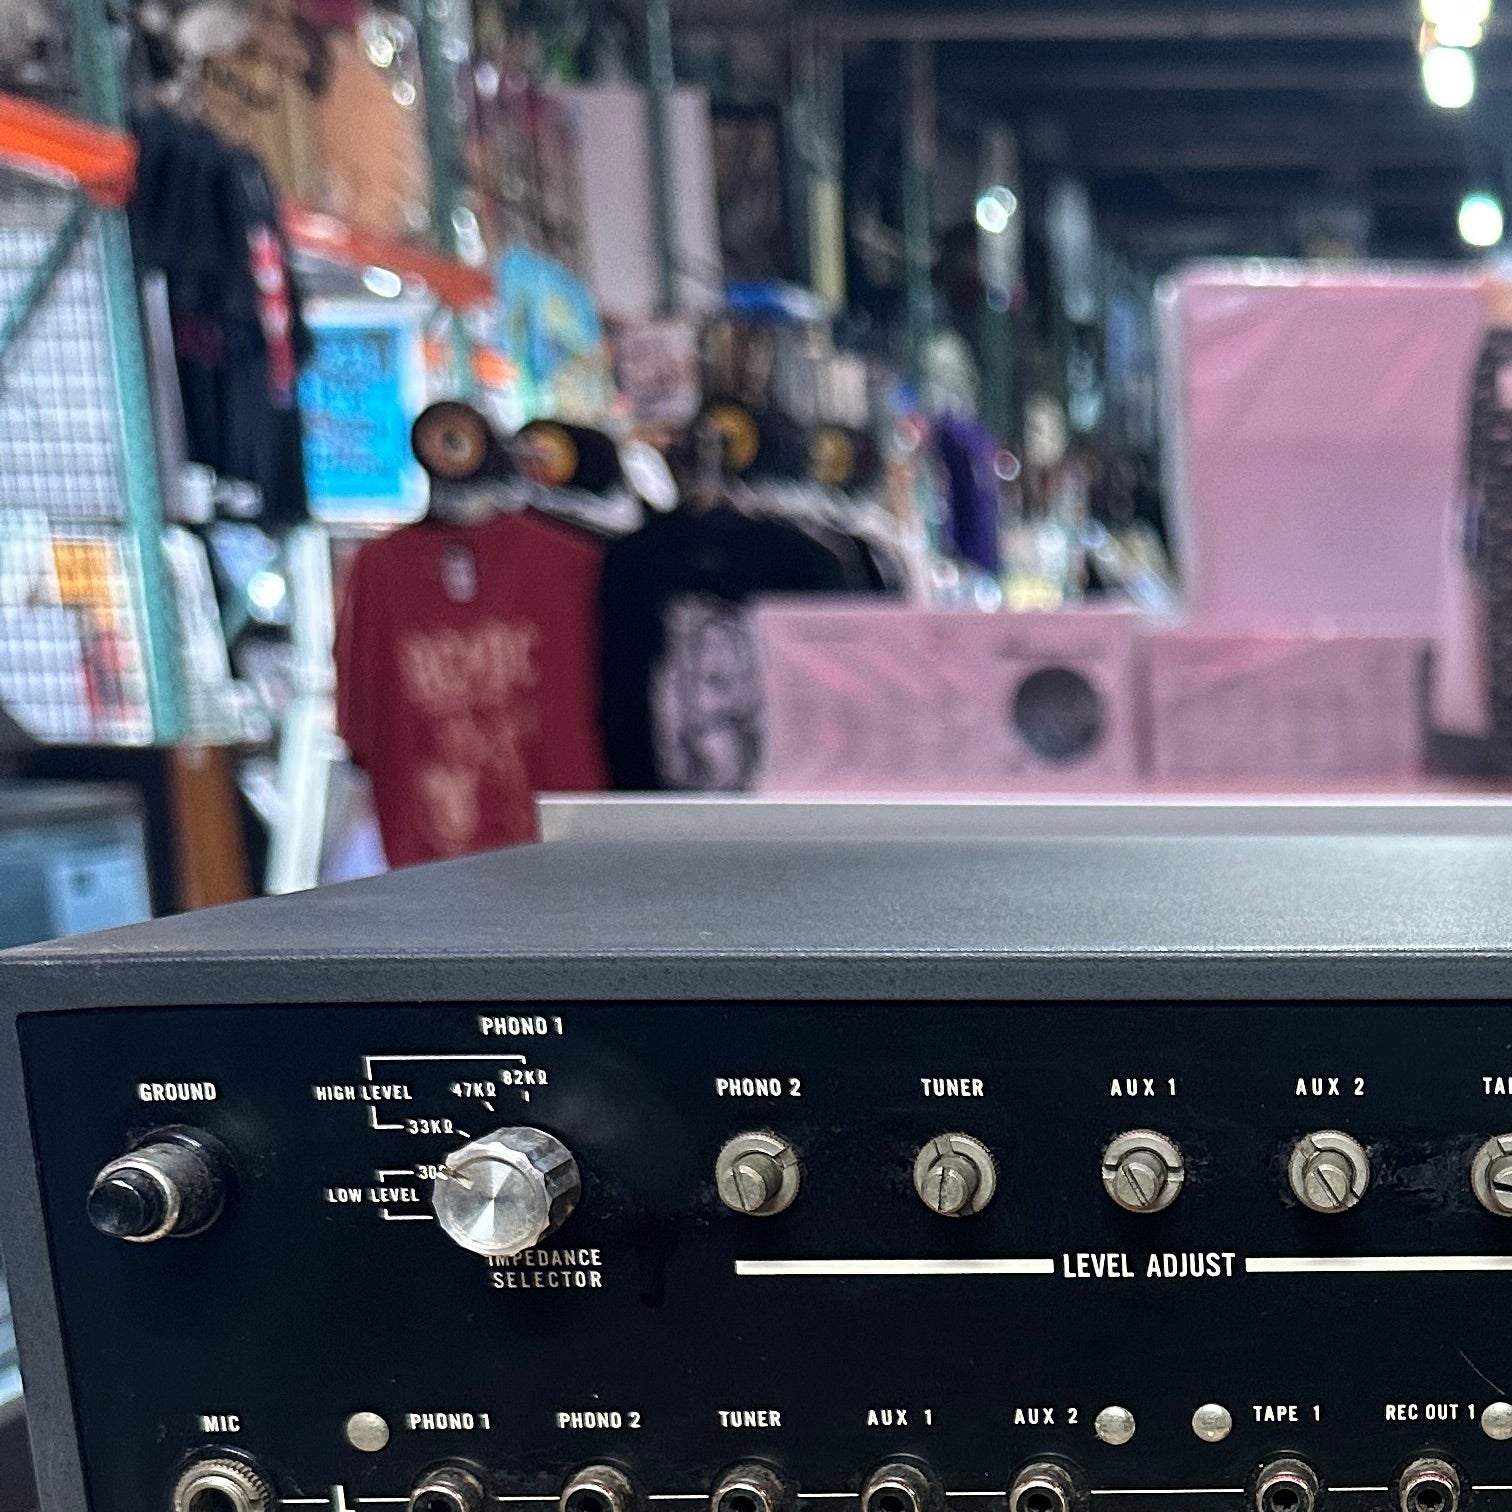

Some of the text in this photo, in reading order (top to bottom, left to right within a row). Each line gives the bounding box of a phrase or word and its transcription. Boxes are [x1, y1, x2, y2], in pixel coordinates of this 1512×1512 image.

[480, 1016, 563, 1036] PHONO 1
[138, 1082, 217, 1102] GROUND
[315, 1084, 413, 1101] HIGH LEVEL
[716, 1077, 802, 1097] PHONO 2
[920, 1077, 984, 1097] TUNER
[1110, 1077, 1176, 1097] AUX 1
[1295, 1077, 1365, 1096] AUX 2
[328, 1187, 420, 1203] LOW LEVEL
[1062, 1252, 1236, 1278] LEVEL ADJUST
[490, 1271, 604, 1290] SELECTOR
[408, 1412, 491, 1430] PHONO 1
[557, 1411, 641, 1429] PHONO 2
[718, 1410, 782, 1428] TUNER
[867, 1409, 932, 1426] AUX 1
[1014, 1407, 1078, 1425] AUX 2
[1252, 1404, 1320, 1422] TAPE 1
[1385, 1403, 1475, 1421] REC OUT 1
[201, 1415, 241, 1433] MIC
